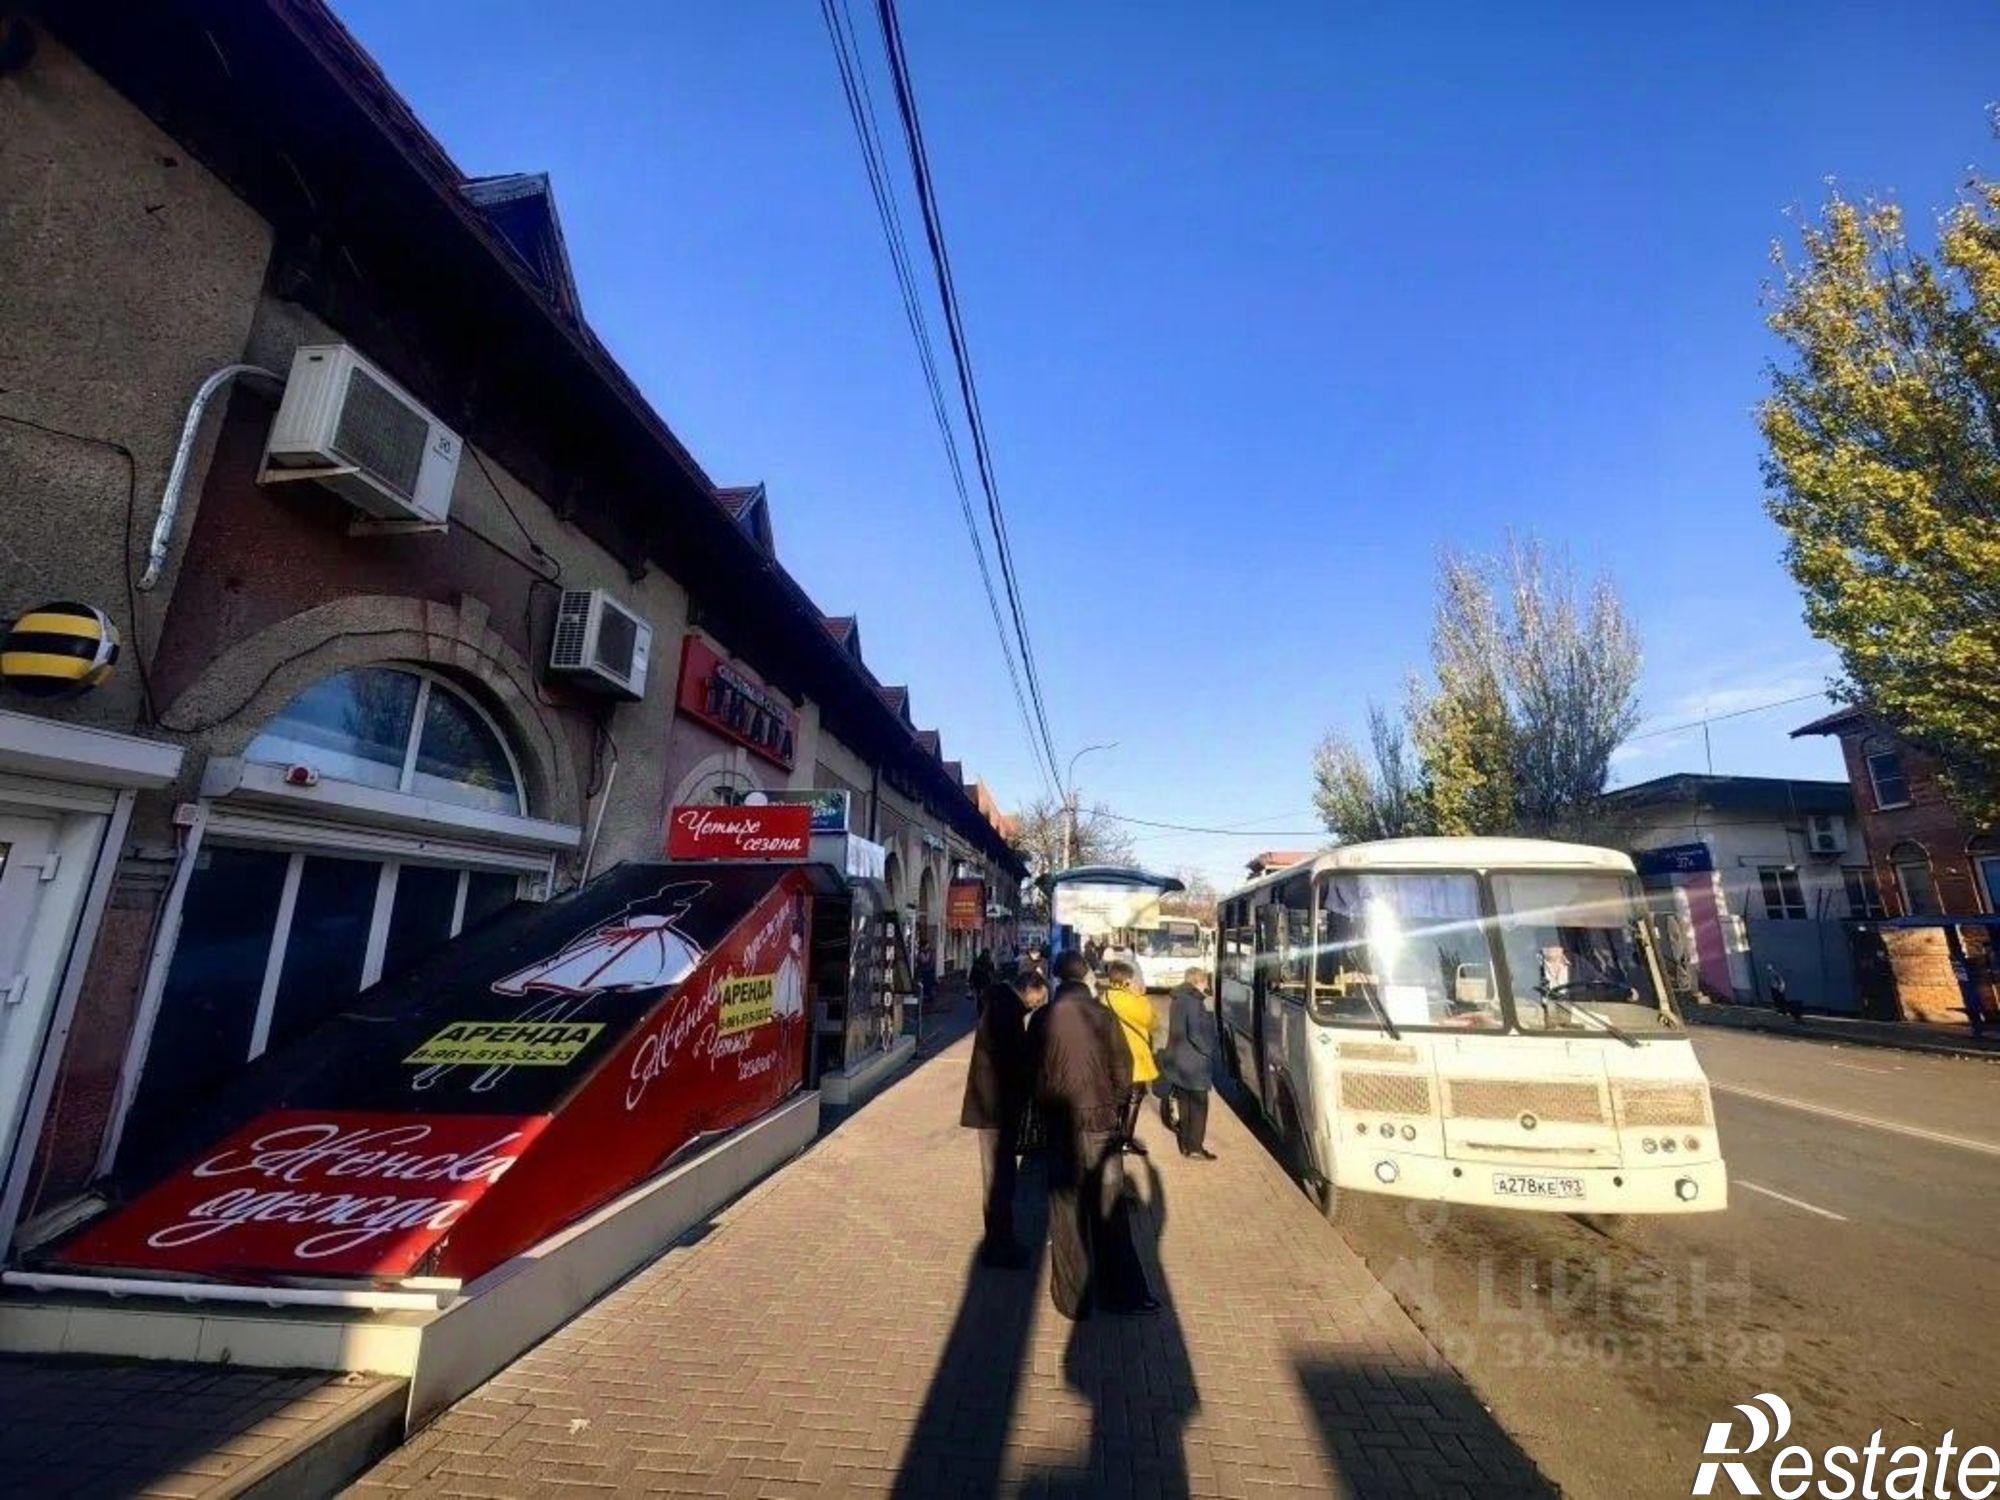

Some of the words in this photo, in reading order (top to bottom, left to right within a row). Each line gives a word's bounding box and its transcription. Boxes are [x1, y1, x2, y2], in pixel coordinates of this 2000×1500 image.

[678, 811, 760, 845] Четыре
[743, 837, 802, 851] сезона
[722, 980, 773, 1006] АРЕНДА
[434, 1026, 592, 1046] АРЕНДА
